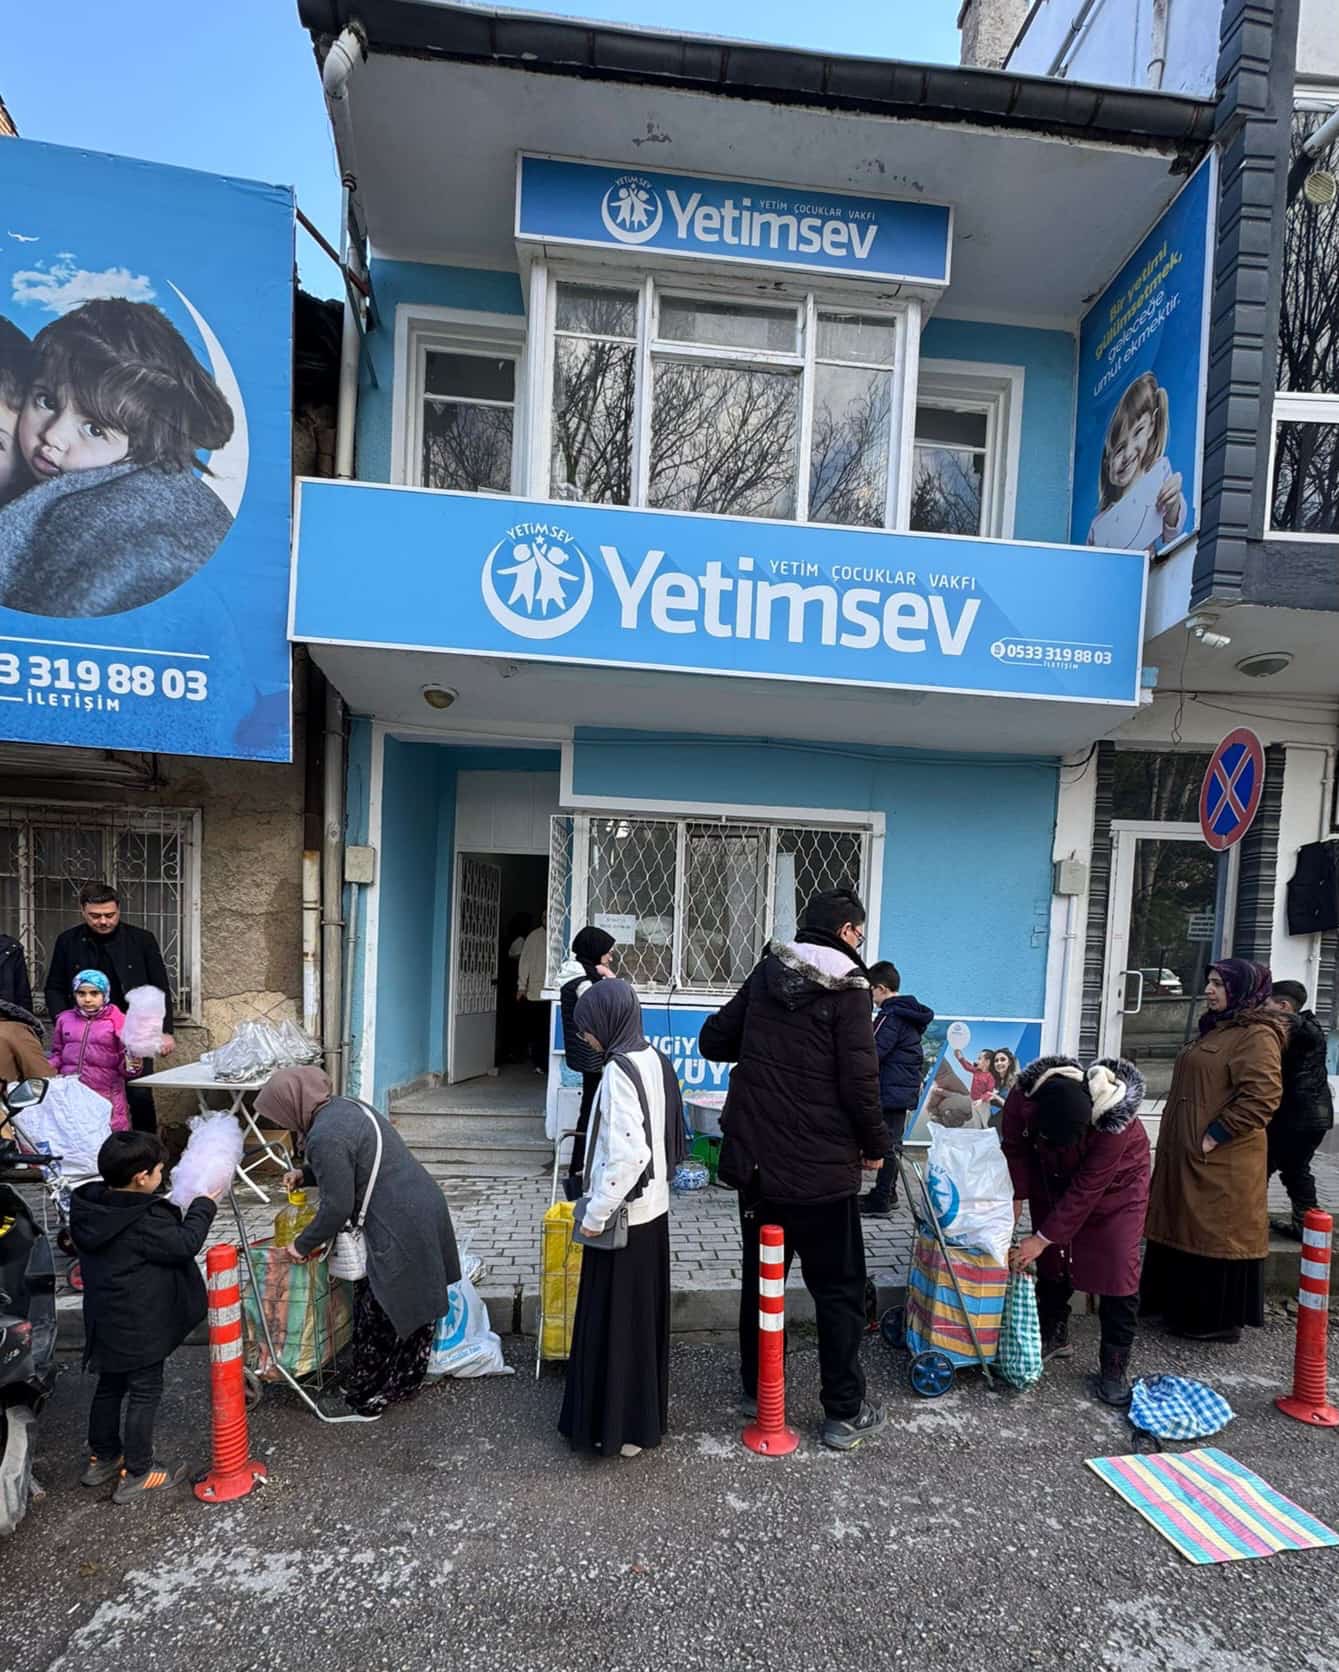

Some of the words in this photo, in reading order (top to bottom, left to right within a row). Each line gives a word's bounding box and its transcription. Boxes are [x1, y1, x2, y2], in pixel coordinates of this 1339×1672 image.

[666, 190, 878, 259] Yetimsev
[759, 199, 788, 211] YETİM
[794, 203, 842, 217] ÇOCUKLAR
[848, 210, 876, 221] VAKFI
[1093, 357, 1123, 397] umut
[1123, 292, 1182, 362] ekmektir.
[1107, 290, 1166, 364] geleceğe
[550, 526, 575, 545] SEV
[769, 559, 819, 577] YETİM
[831, 565, 917, 585] ÇOCUKLAR
[928, 573, 976, 591] VAKFI
[599, 545, 982, 656] Yetimsev
[1007, 644, 1042, 660] 0533
[1044, 647, 1072, 661] 319
[1073, 649, 1092, 664] 88
[1094, 651, 1112, 665] 03
[28, 655, 101, 692] 319
[107, 663, 156, 697] 88
[161, 668, 208, 701] 03
[27, 688, 120, 712] İLETİŞİM
